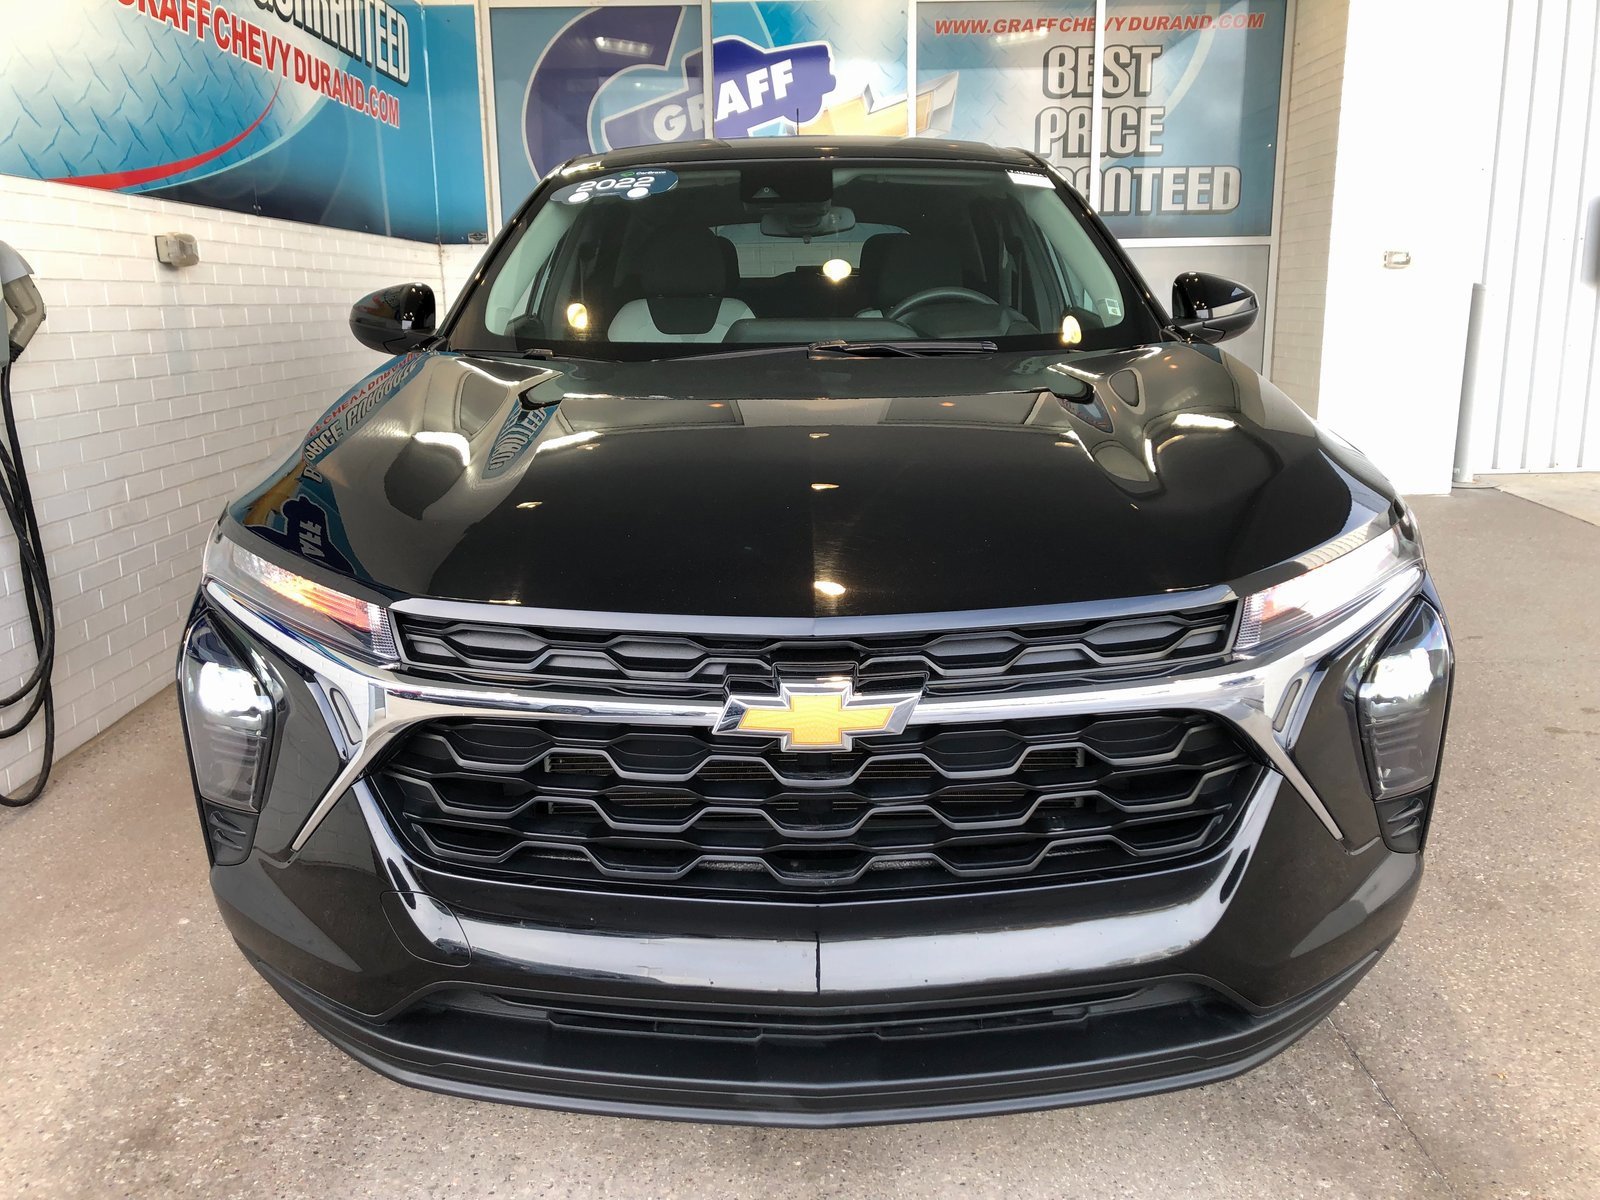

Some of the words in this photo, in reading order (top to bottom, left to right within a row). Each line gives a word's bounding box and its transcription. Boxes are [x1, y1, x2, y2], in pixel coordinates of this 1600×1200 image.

[117, 0, 400, 127] AFFCHEVYDURAND.COM
[1042, 45, 1163, 99] BEST
[653, 58, 794, 142] GRAFF
[1034, 105, 1166, 158] PRICE
[575, 176, 656, 193] 2022
